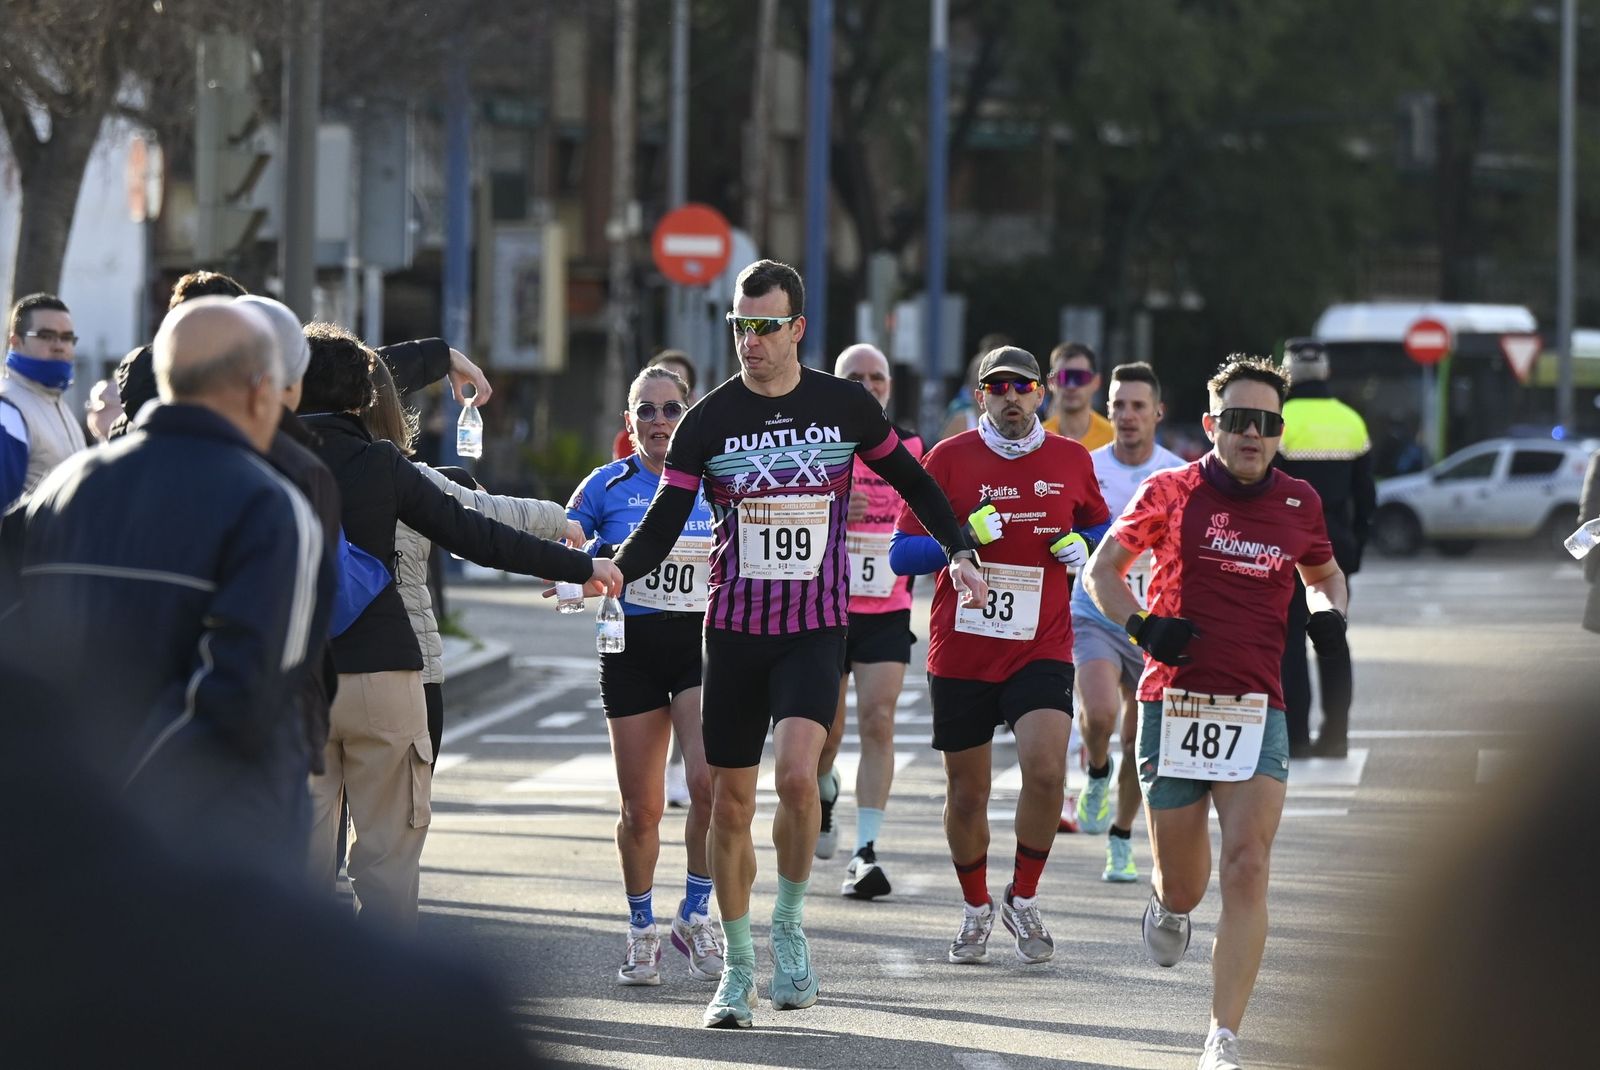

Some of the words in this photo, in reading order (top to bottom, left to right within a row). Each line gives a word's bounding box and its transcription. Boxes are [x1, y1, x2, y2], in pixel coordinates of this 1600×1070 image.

[724, 423, 841, 454] DUATLÓN
[745, 449, 823, 493] XX
[988, 486, 1018, 498] califas
[743, 503, 771, 525] XLII
[759, 527, 811, 561] 199
[1205, 527, 1241, 541] PINK
[1211, 537, 1281, 558] RUNNING
[862, 557, 875, 582] 5
[1255, 554, 1284, 572] ON
[646, 562, 694, 594] 390
[983, 590, 1014, 622] 33
[1167, 694, 1200, 719] XLII
[1181, 721, 1242, 761] 487
